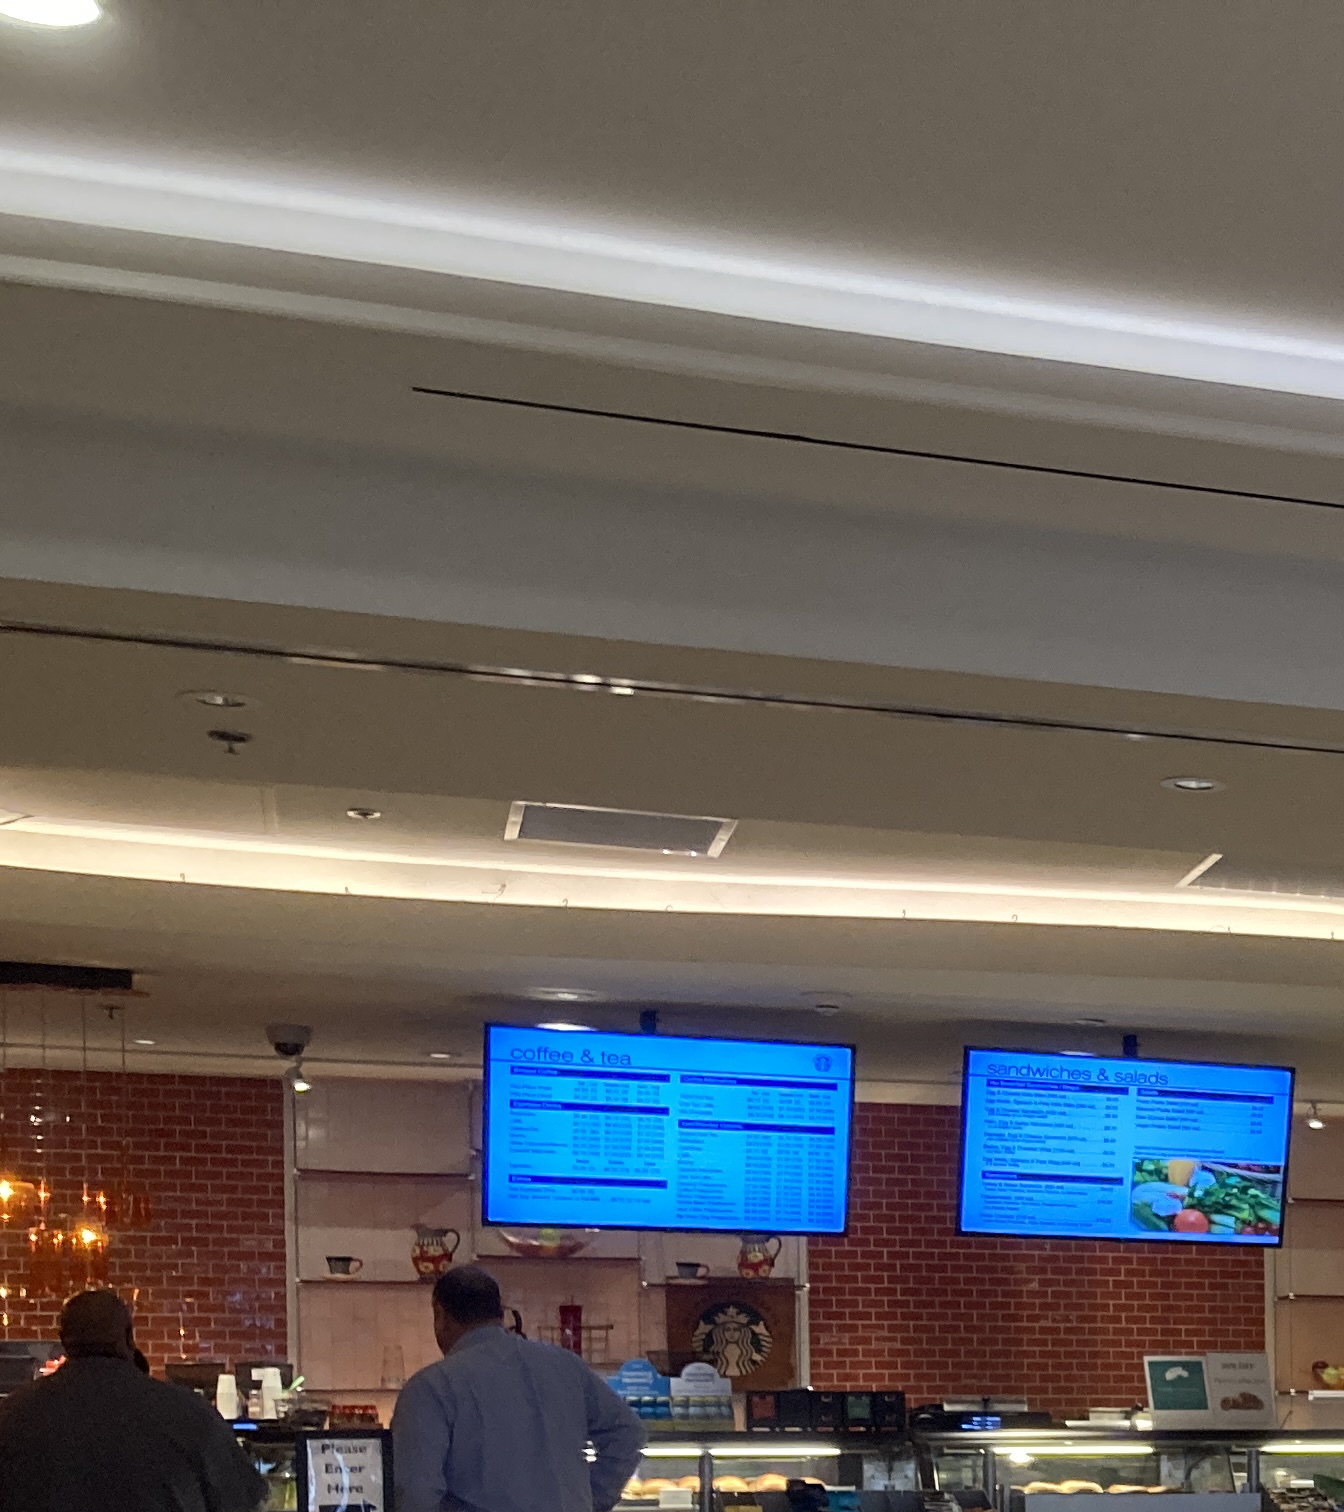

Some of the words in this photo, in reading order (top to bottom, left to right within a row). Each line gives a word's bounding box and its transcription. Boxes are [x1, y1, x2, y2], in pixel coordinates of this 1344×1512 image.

[510, 1046, 574, 1064] coffee
[580, 1048, 595, 1064] &
[600, 1050, 632, 1067] tea
[986, 1062, 1092, 1081] sandwiches
[1096, 1067, 1109, 1082] &
[1113, 1069, 1169, 1086] salads
[325, 1463, 365, 1474] Ener
